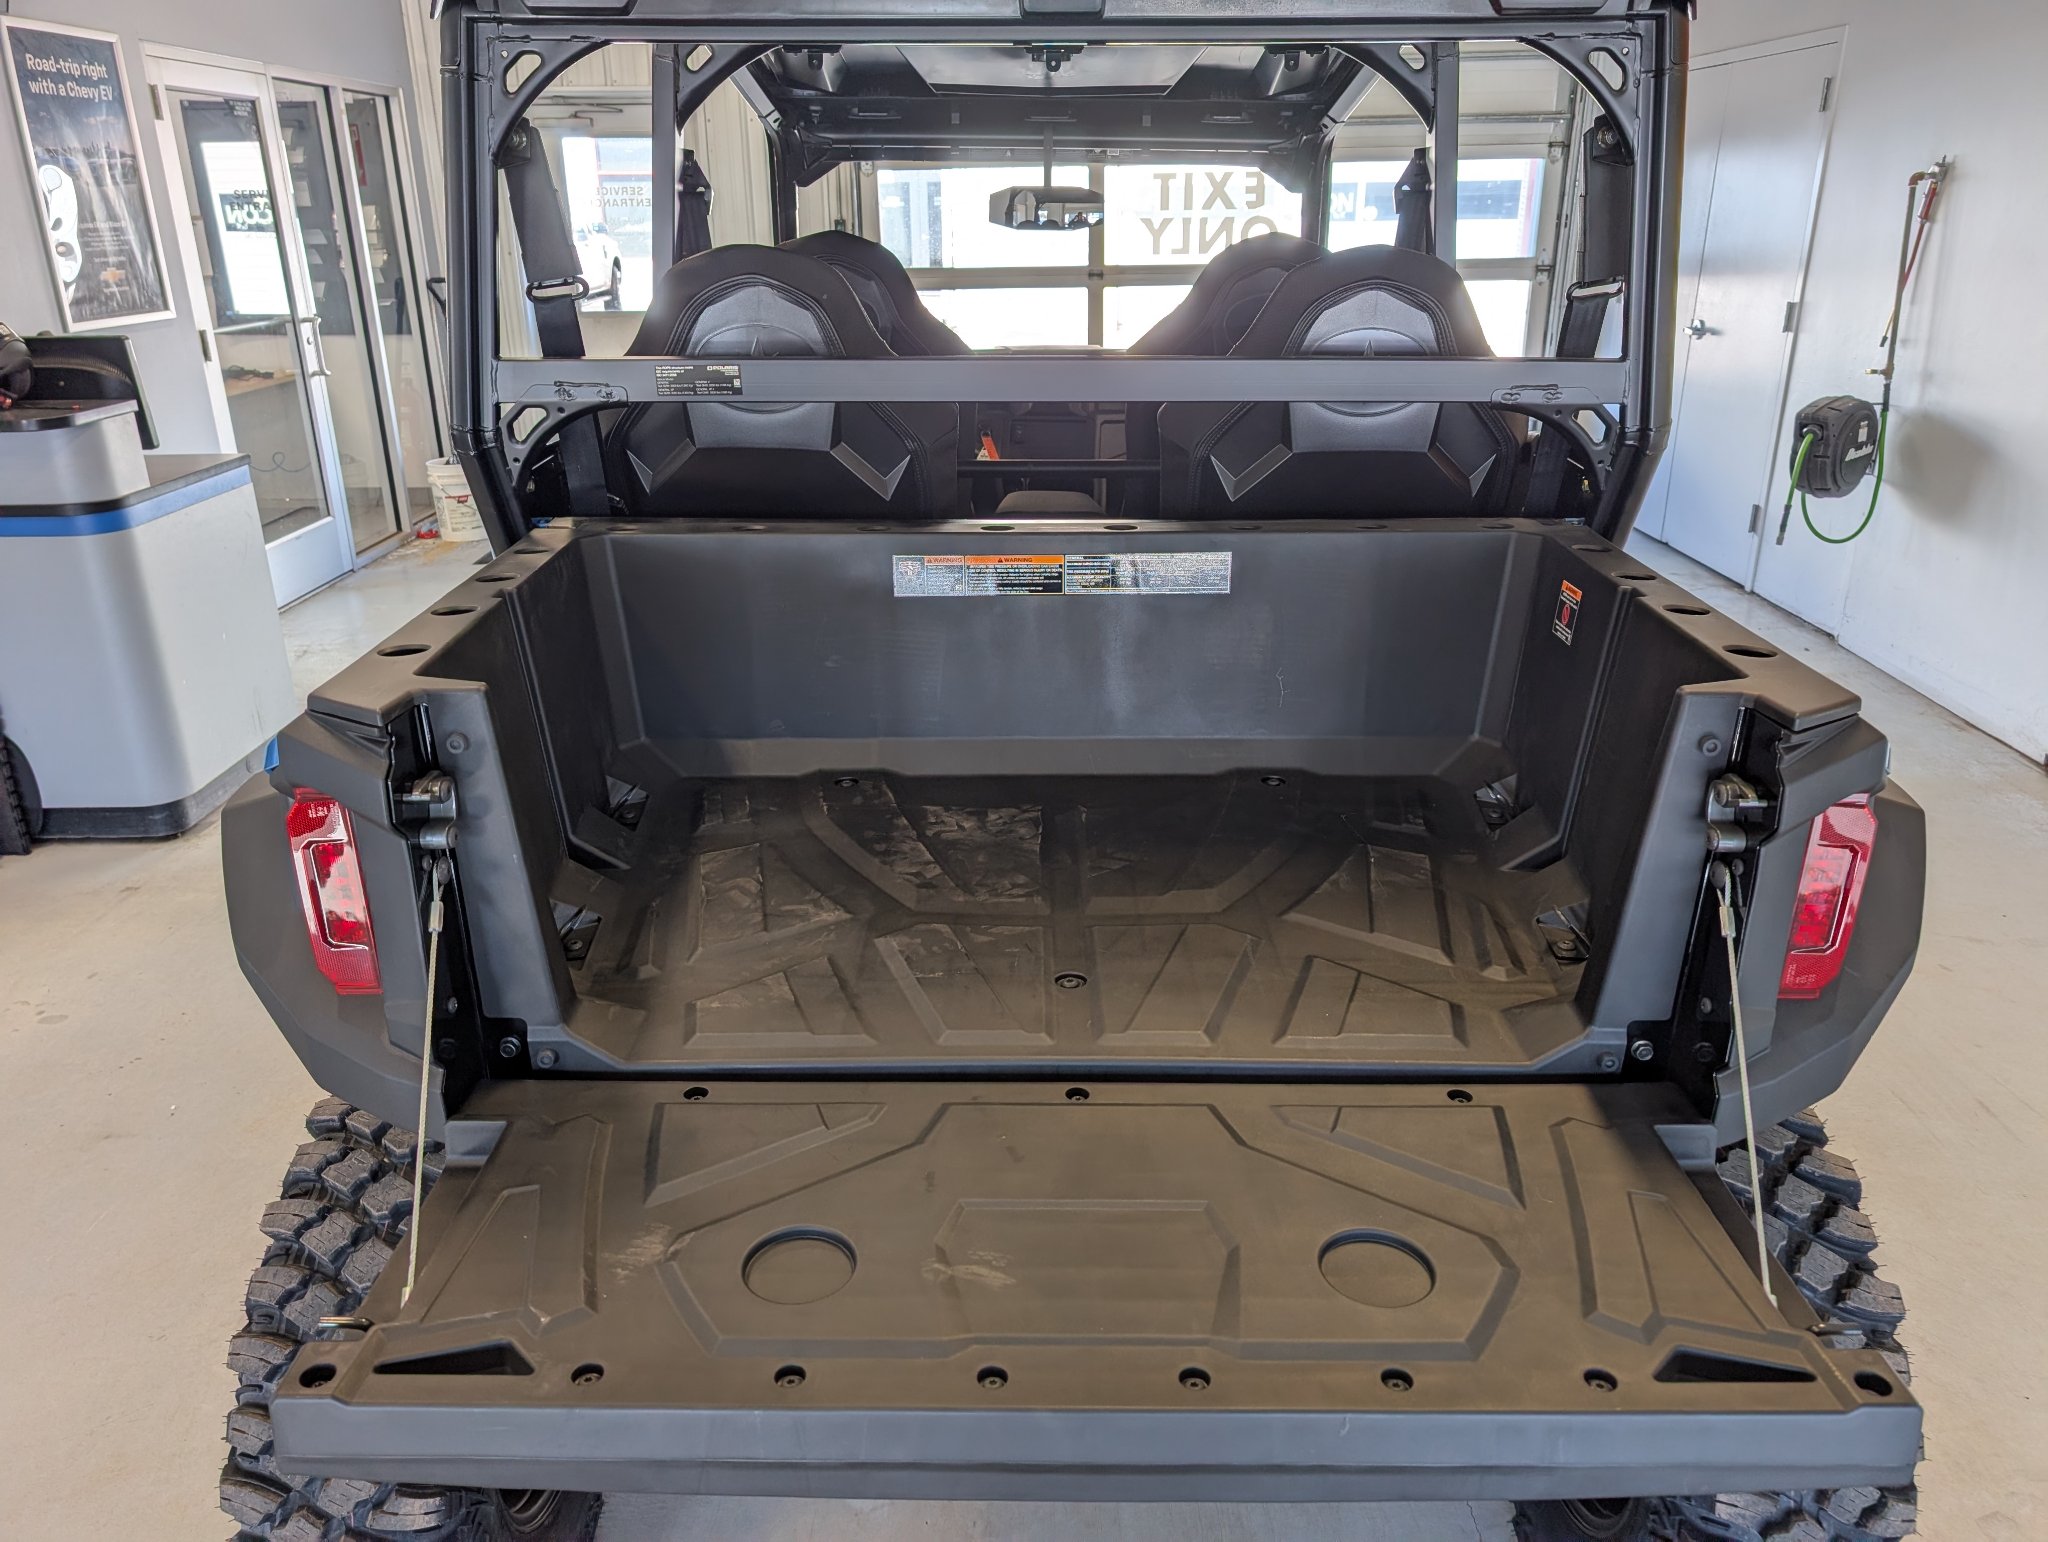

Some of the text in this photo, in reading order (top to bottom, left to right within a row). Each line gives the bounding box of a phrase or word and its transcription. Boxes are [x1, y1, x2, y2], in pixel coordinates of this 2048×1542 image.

[25, 53, 108, 81] Road-trip right
[28, 77, 113, 103] with a Chevy EV
